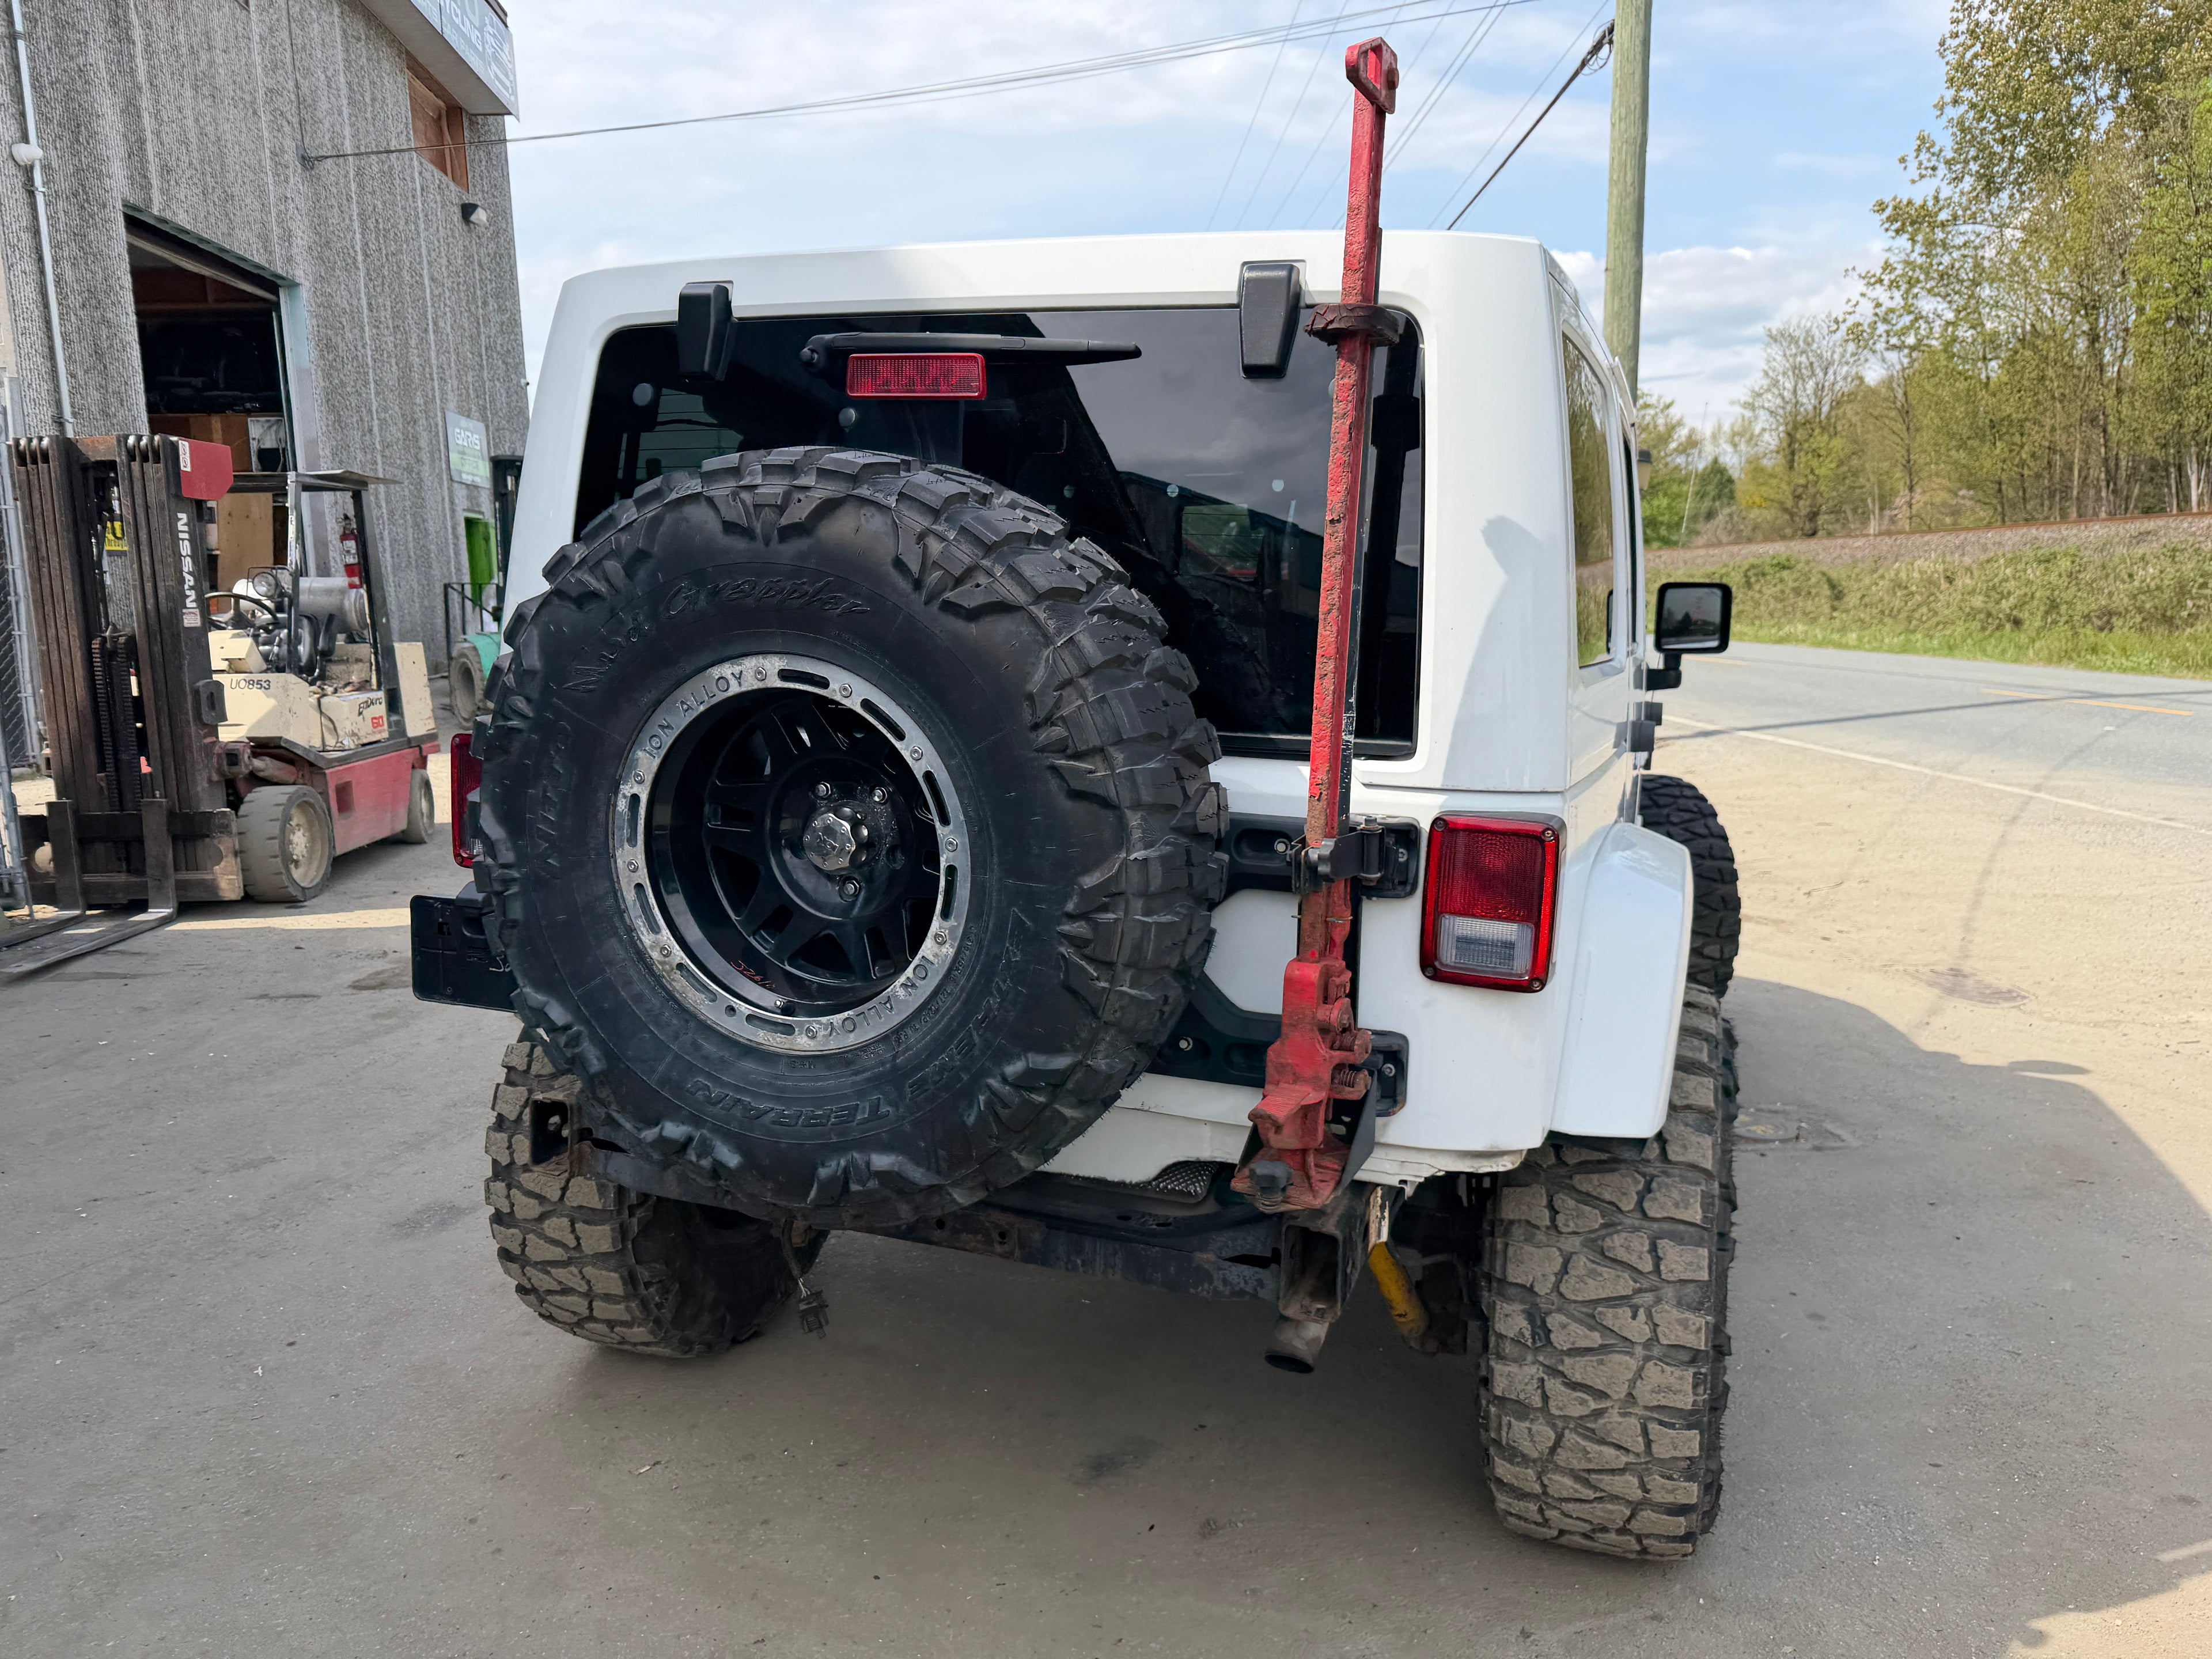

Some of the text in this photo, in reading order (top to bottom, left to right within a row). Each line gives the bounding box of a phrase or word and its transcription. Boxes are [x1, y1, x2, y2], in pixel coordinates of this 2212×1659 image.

[176, 512, 198, 608] NISSAN
[660, 577, 871, 618] Grappler
[371, 715, 384, 729] 60
[642, 717, 675, 760] ION
[676, 670, 744, 719] ALLOY
[827, 955, 936, 1037] ION ALLOY
[685, 1078, 892, 1127] TERRAIN
